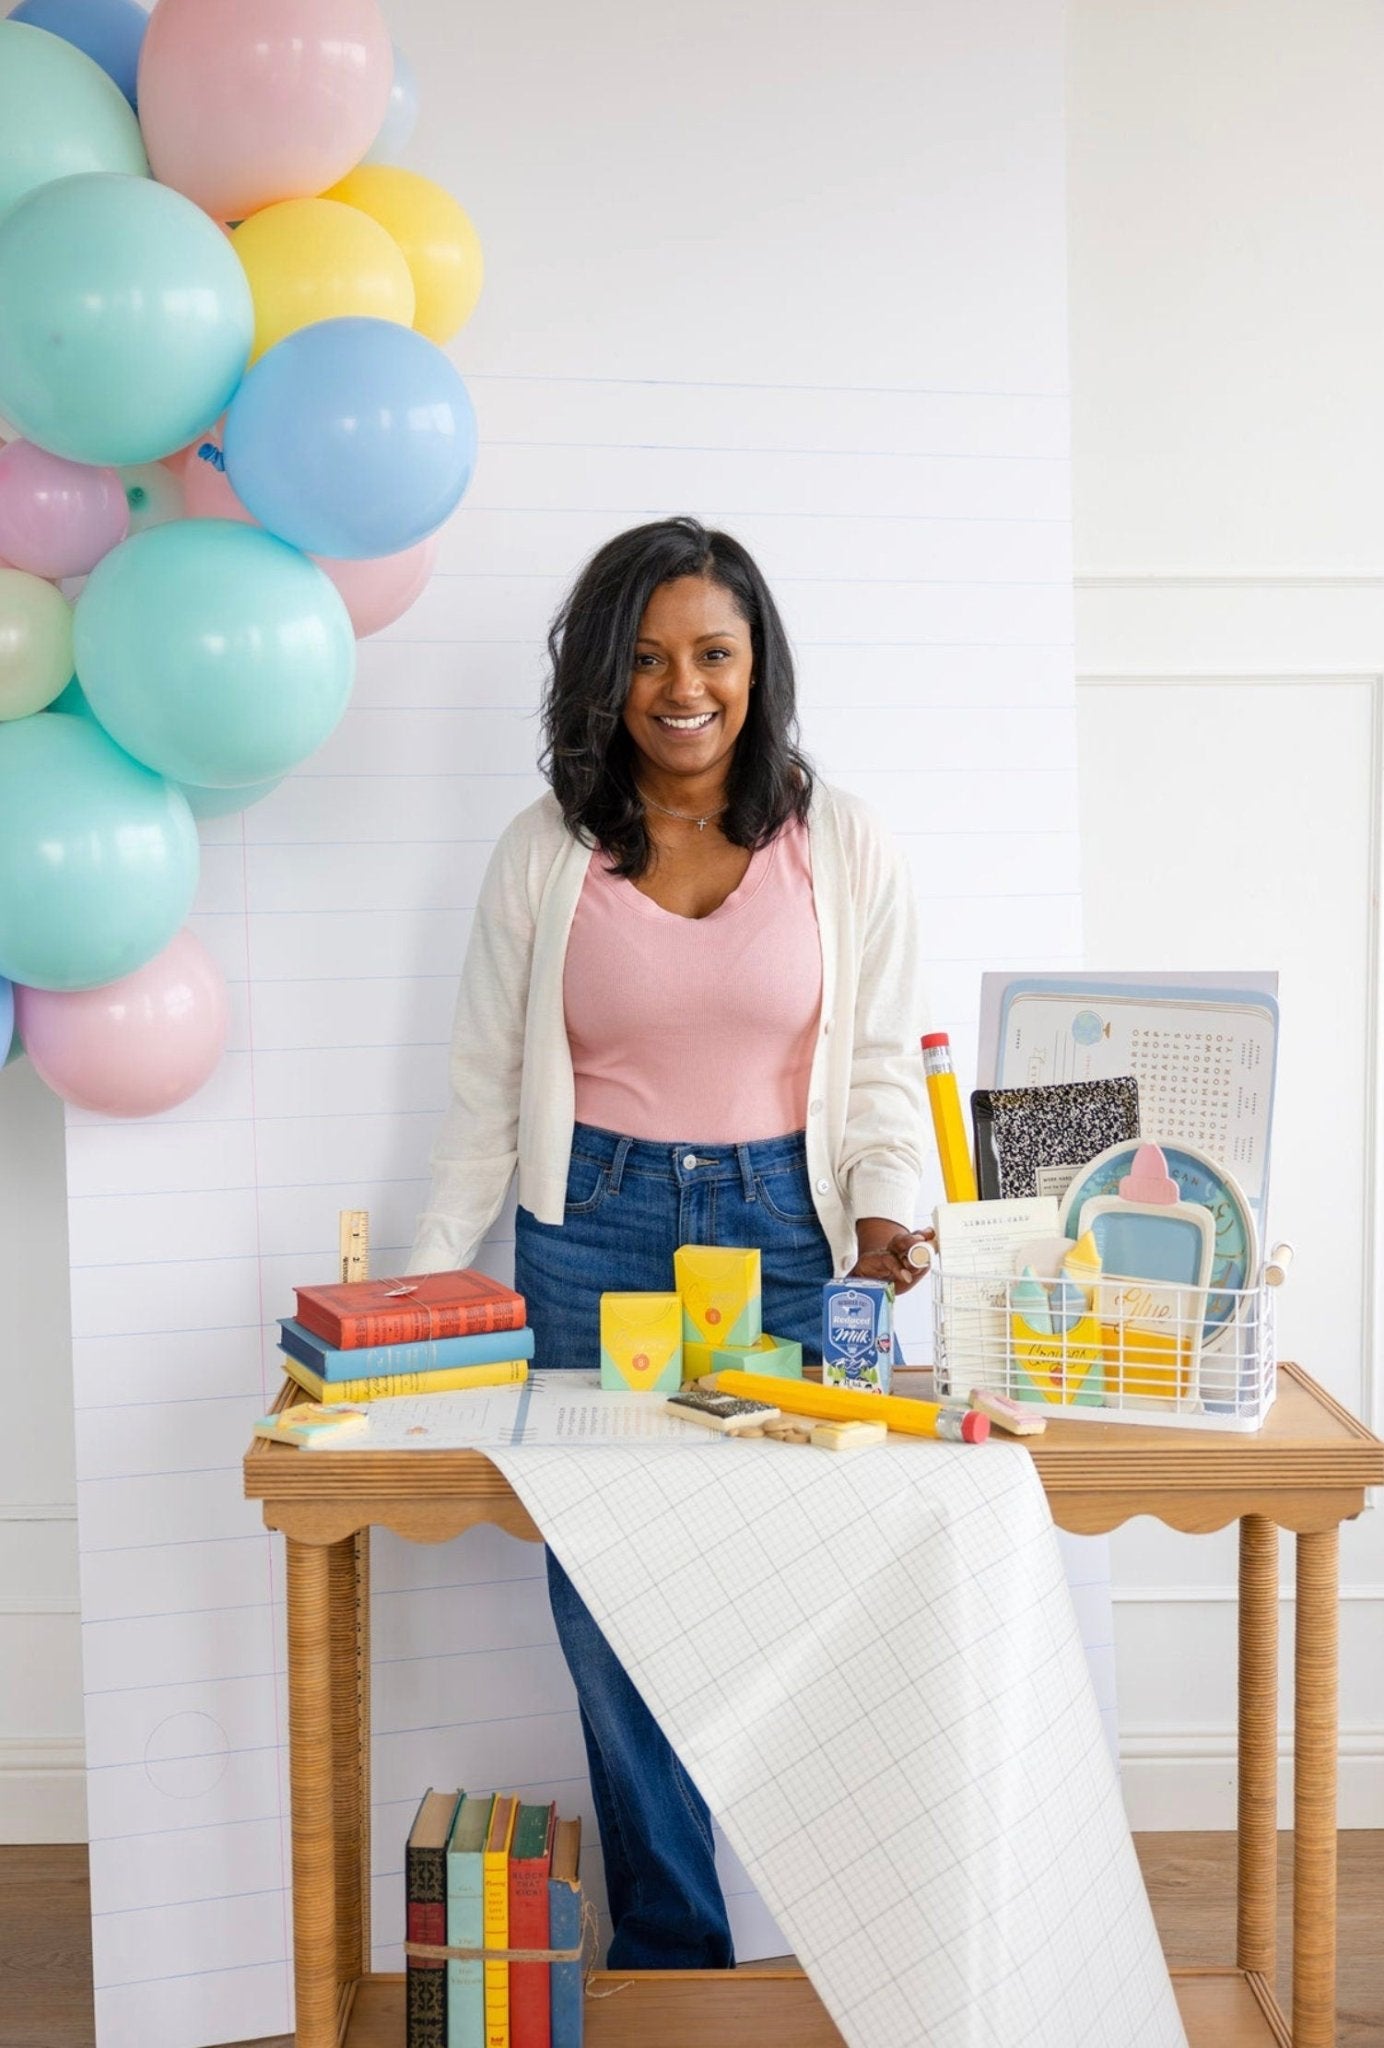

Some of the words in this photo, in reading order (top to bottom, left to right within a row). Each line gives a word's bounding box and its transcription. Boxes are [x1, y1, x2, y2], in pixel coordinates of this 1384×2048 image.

[1172, 1169, 1200, 1186] CAN
[1114, 1287, 1173, 1331] Glue
[833, 1315, 871, 1326] Reduced
[834, 1328, 869, 1344] Milk
